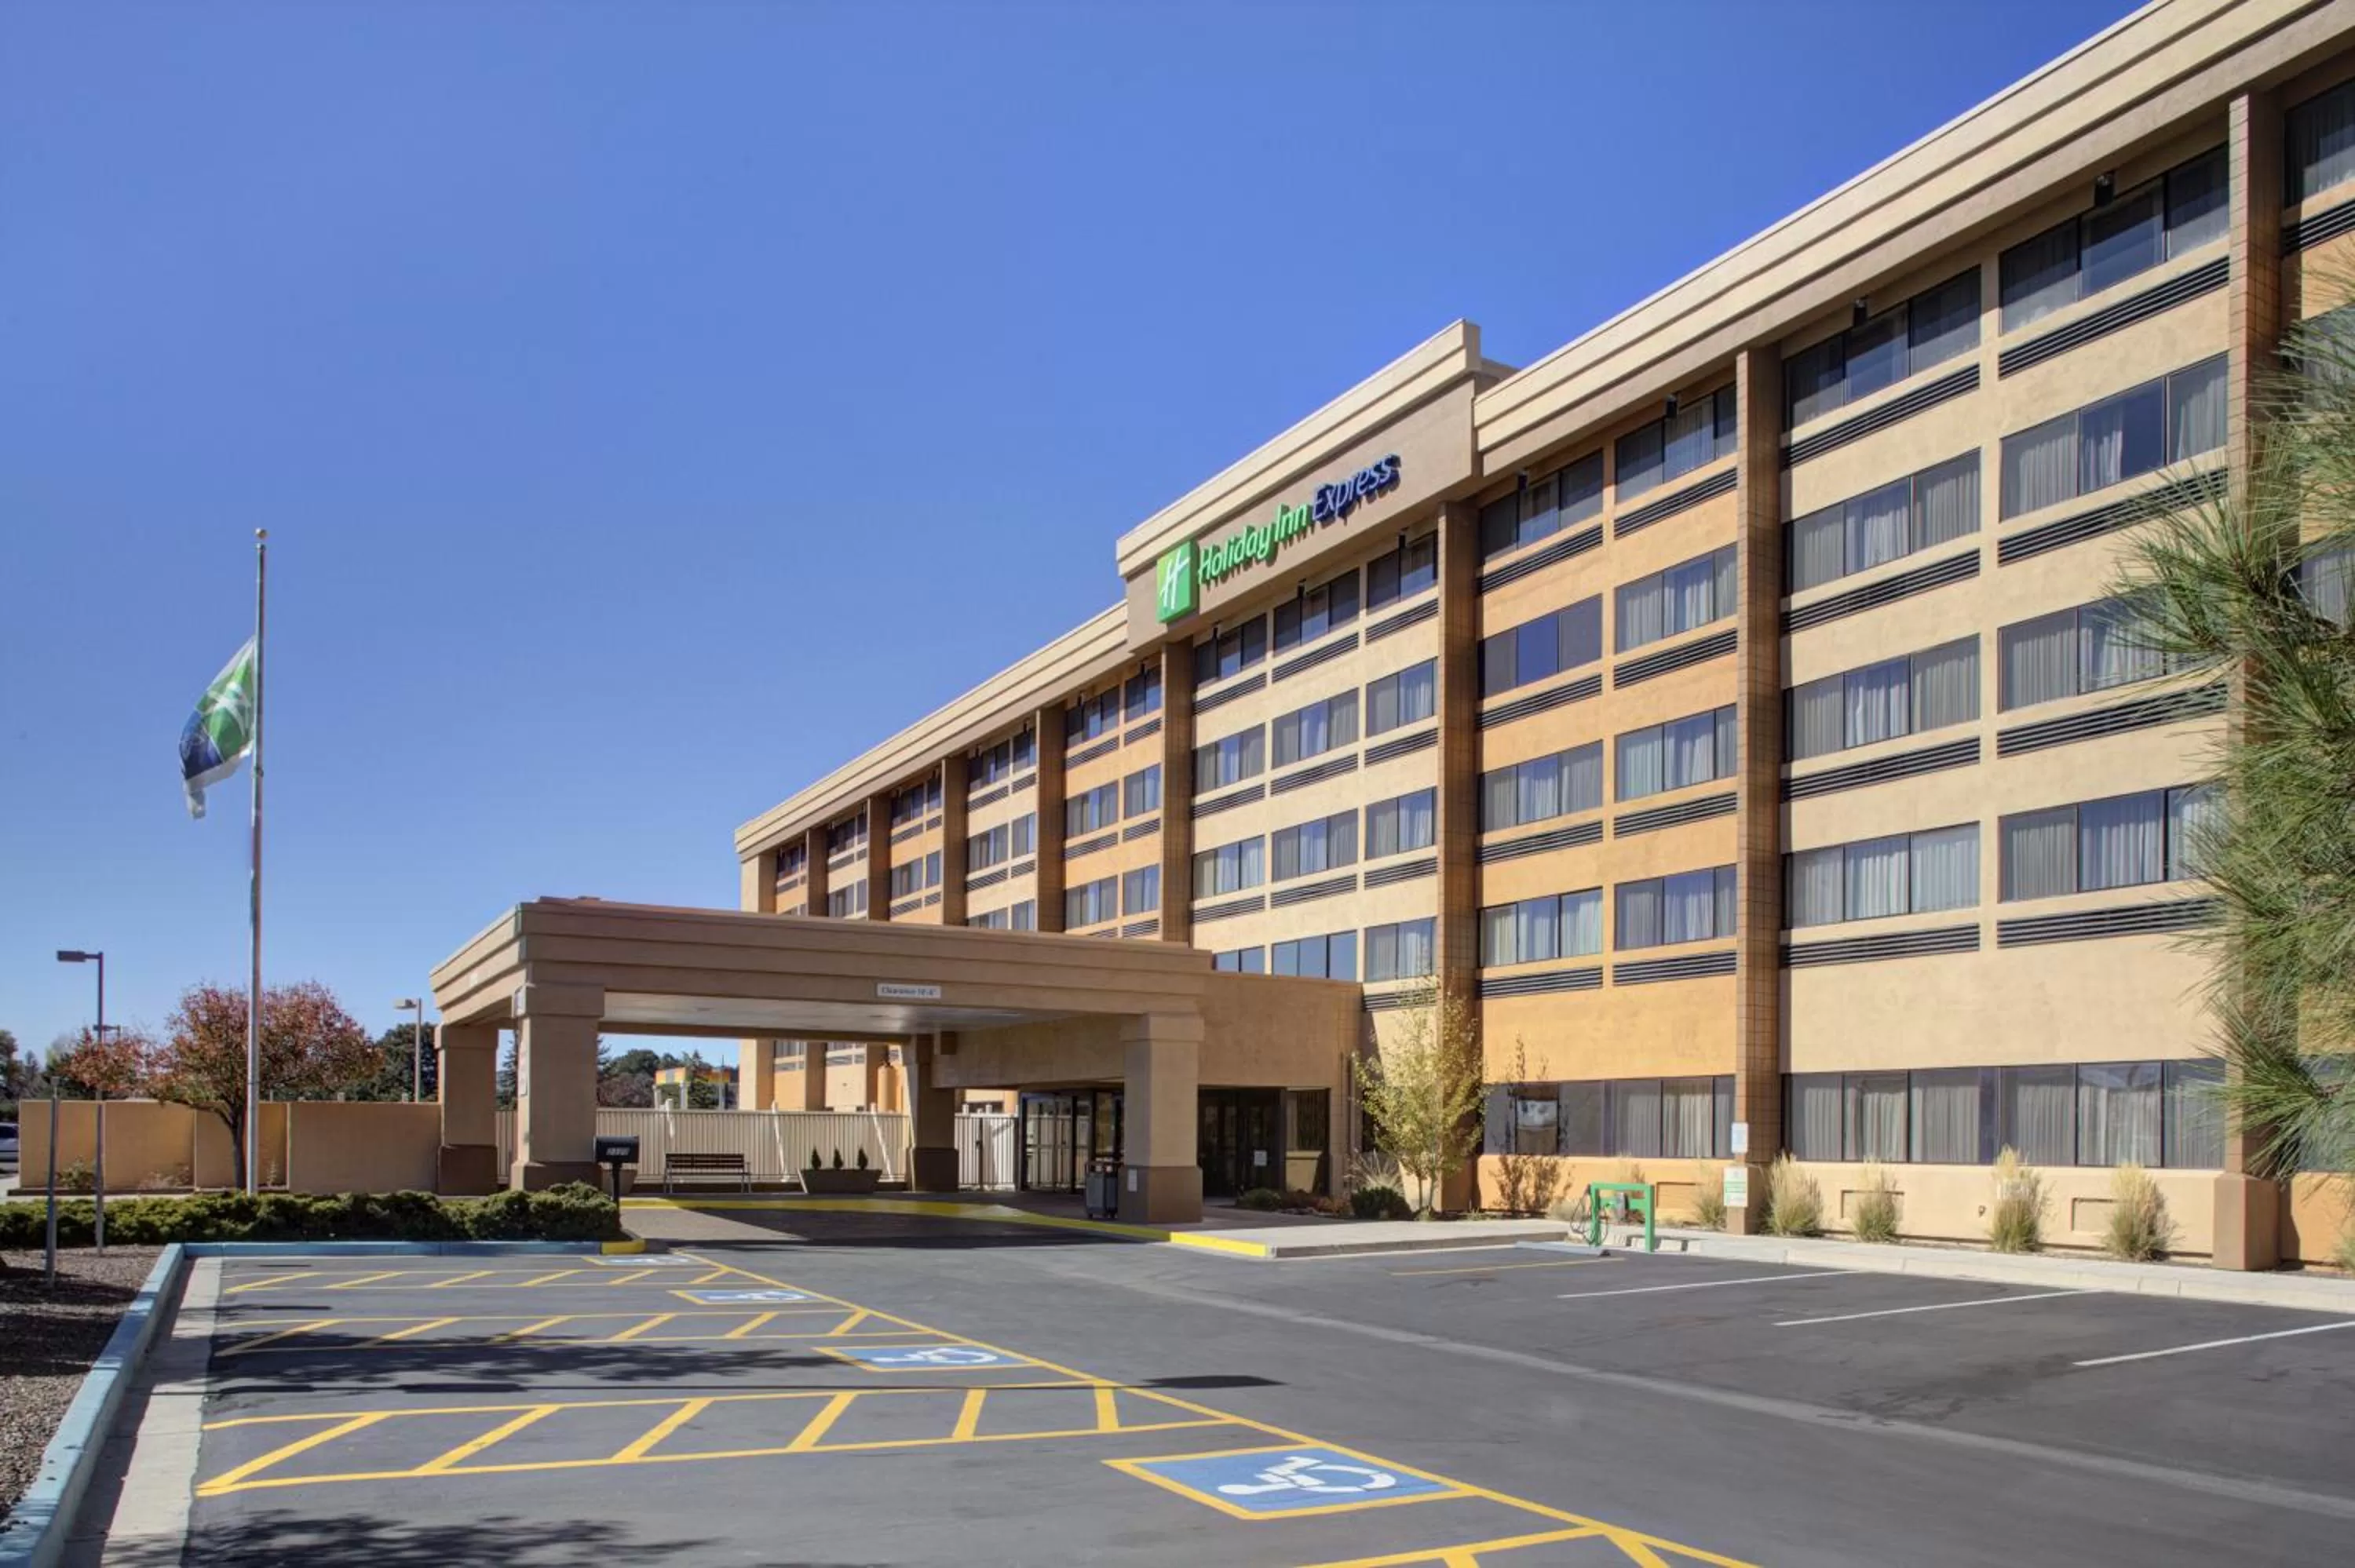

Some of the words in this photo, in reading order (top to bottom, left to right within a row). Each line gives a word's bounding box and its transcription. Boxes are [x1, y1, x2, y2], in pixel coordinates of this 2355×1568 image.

[1198, 523, 1273, 585] Holiday
[1274, 502, 1310, 542] Inn
[1313, 452, 1400, 520] Express
